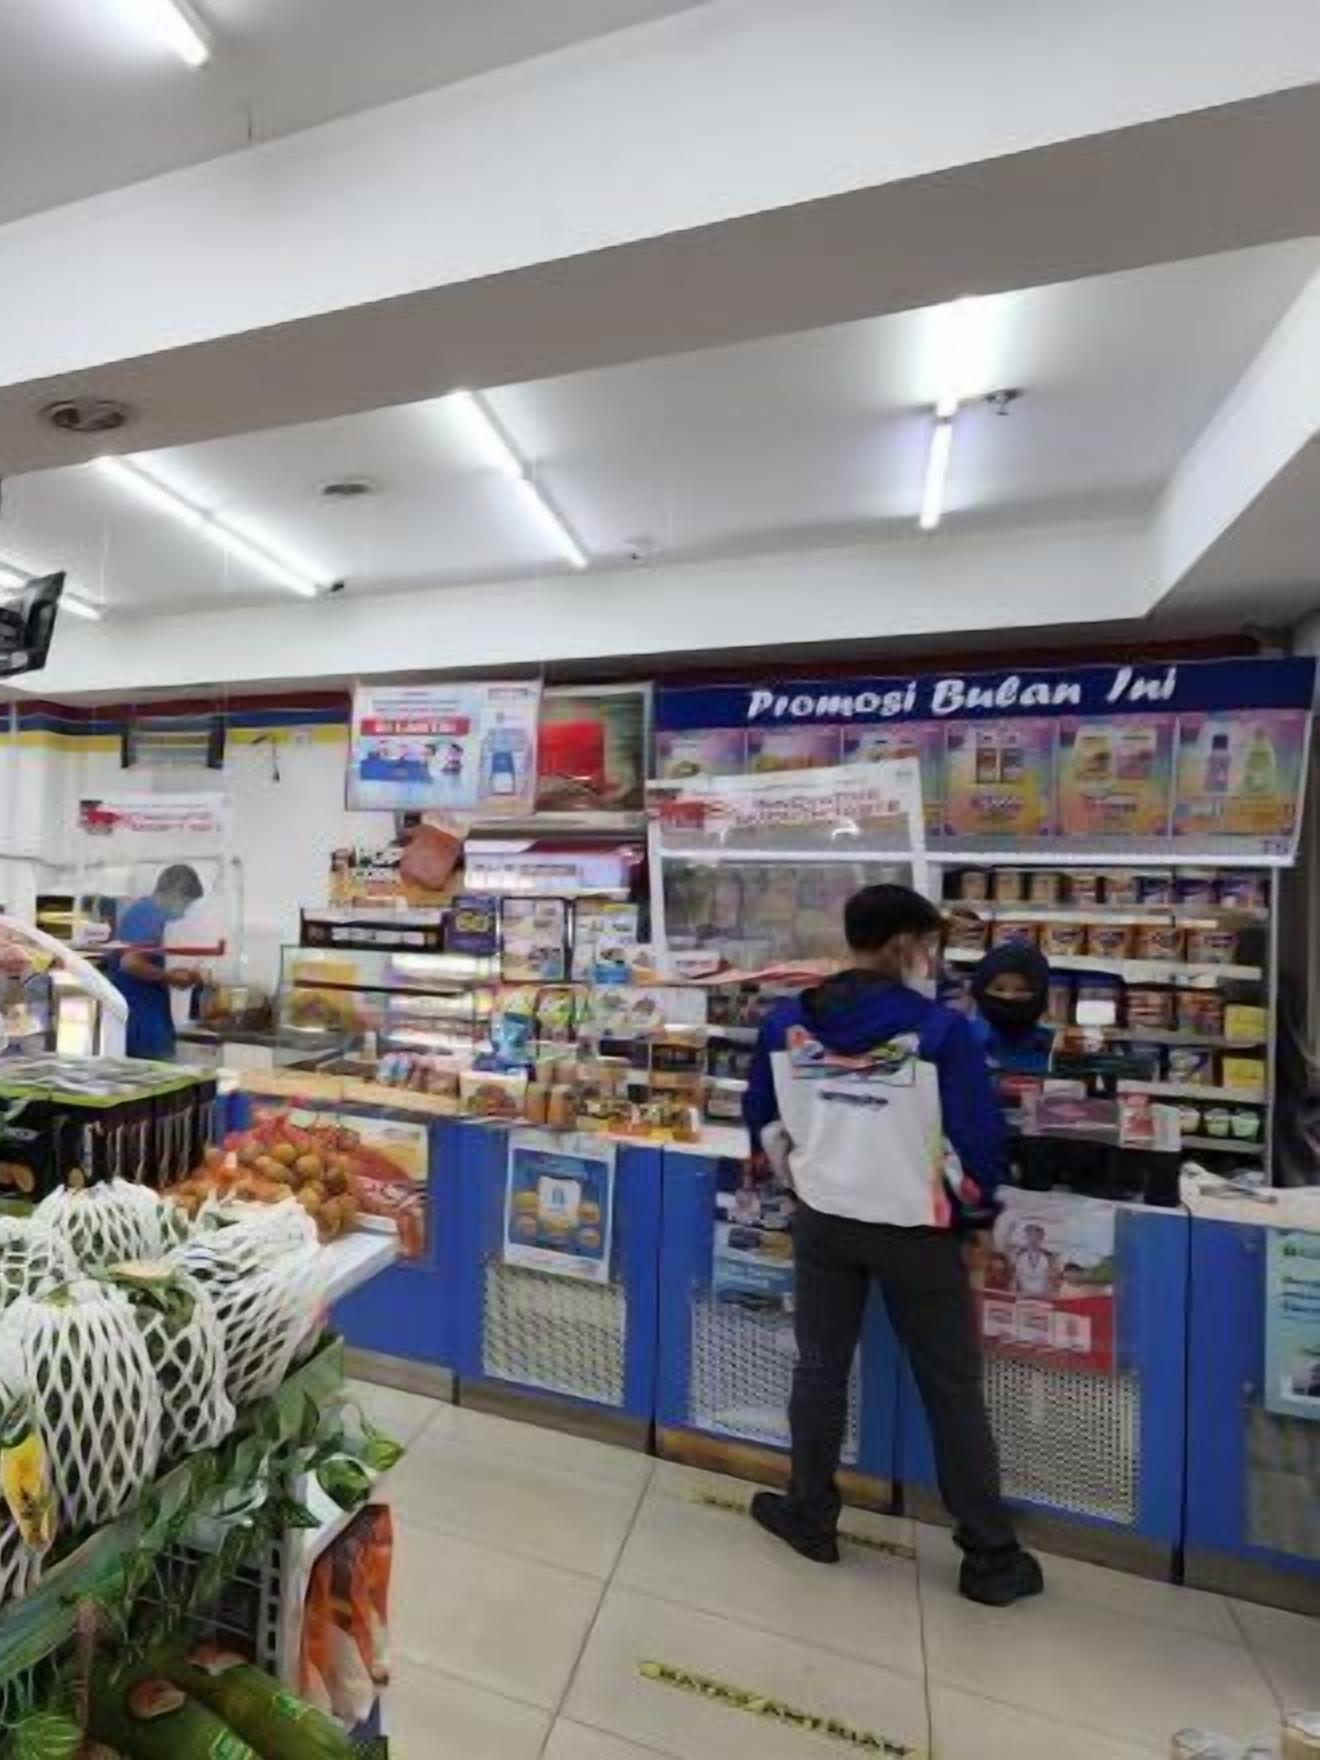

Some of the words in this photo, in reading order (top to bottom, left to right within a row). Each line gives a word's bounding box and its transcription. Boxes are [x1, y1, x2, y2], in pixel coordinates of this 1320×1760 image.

[746, 681, 916, 720] Promosi
[931, 676, 1081, 715] Bulan
[1107, 666, 1177, 703] Ini
